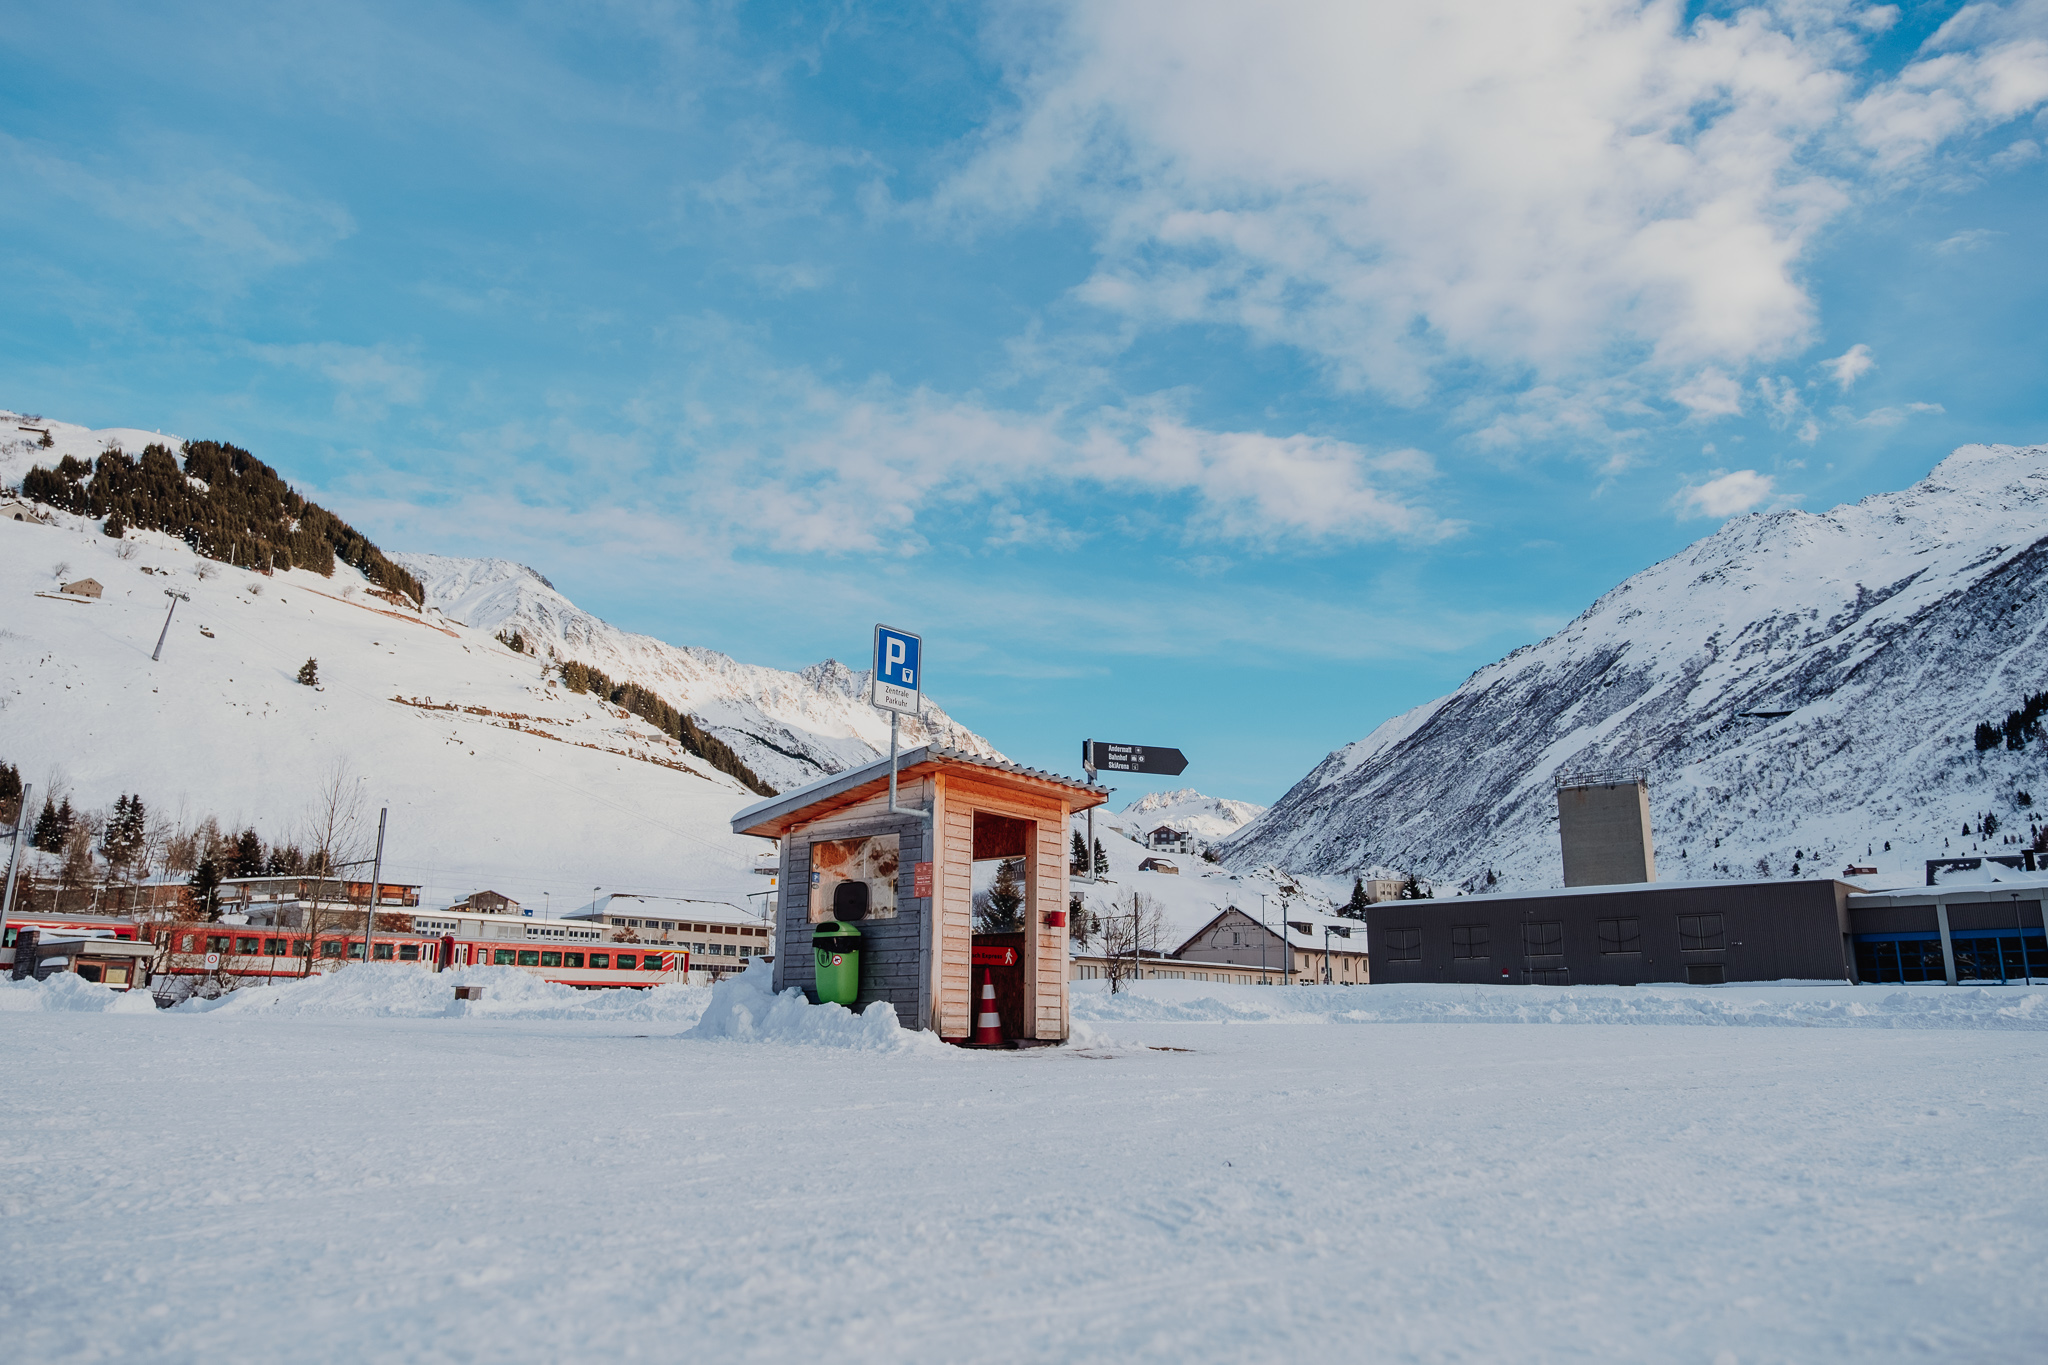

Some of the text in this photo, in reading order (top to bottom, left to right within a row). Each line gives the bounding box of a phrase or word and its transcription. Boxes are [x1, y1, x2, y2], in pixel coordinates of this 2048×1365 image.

[885, 636, 906, 675] P
[885, 686, 909, 698] Zentrale
[885, 696, 908, 707] Parkuhr
[1108, 745, 1132, 753] Andermatt
[1108, 753, 1127, 761] Bahnhof
